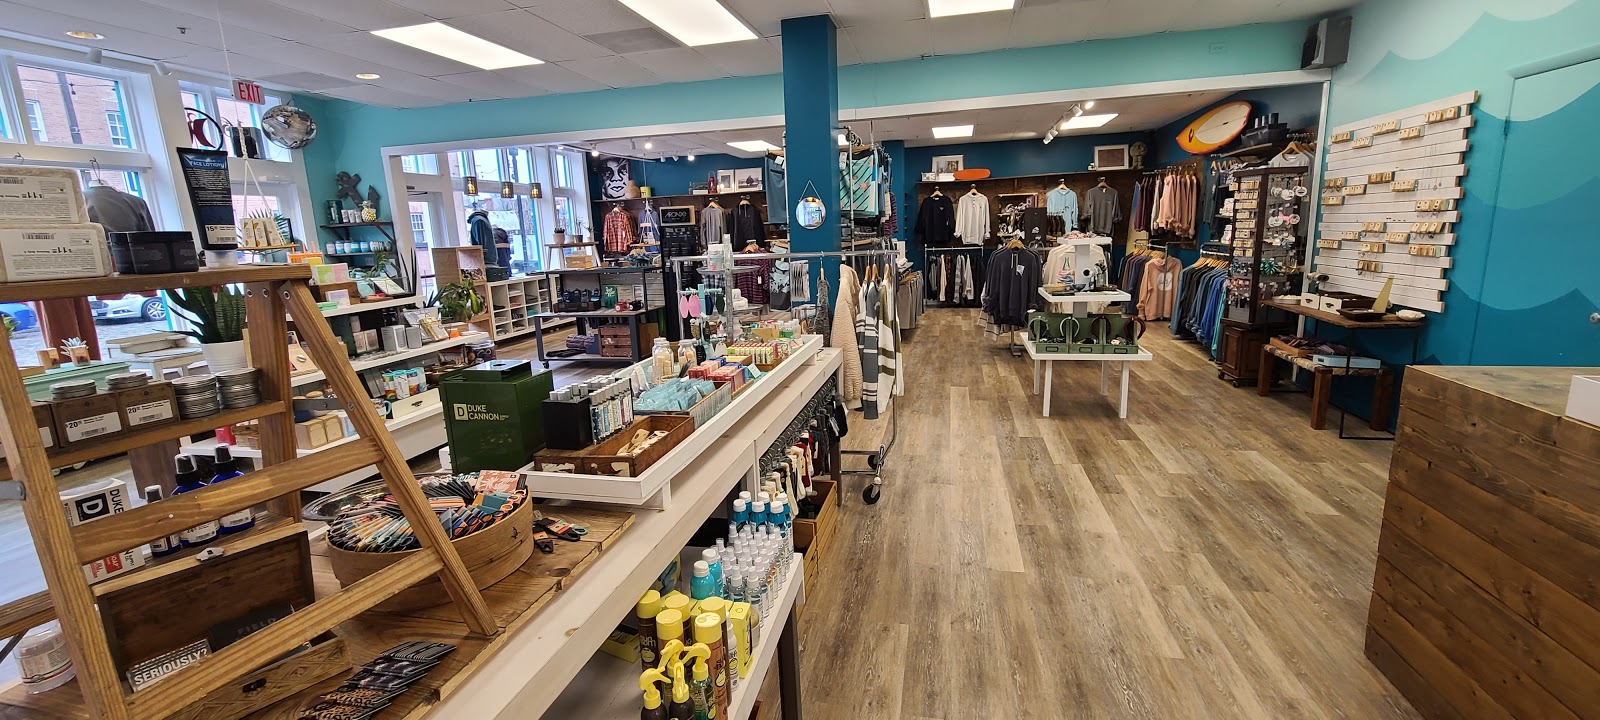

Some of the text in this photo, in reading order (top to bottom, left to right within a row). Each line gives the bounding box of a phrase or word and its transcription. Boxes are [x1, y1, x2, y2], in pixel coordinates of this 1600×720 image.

[237, 81, 262, 103] EXIT
[457, 406, 465, 416] D
[467, 404, 487, 412] DUKE
[468, 412, 500, 421] CANNON
[82, 498, 103, 514] D
[109, 488, 124, 514] DUKE
[237, 617, 277, 635] FIELD
[134, 648, 208, 685] SERIOUSLY?
